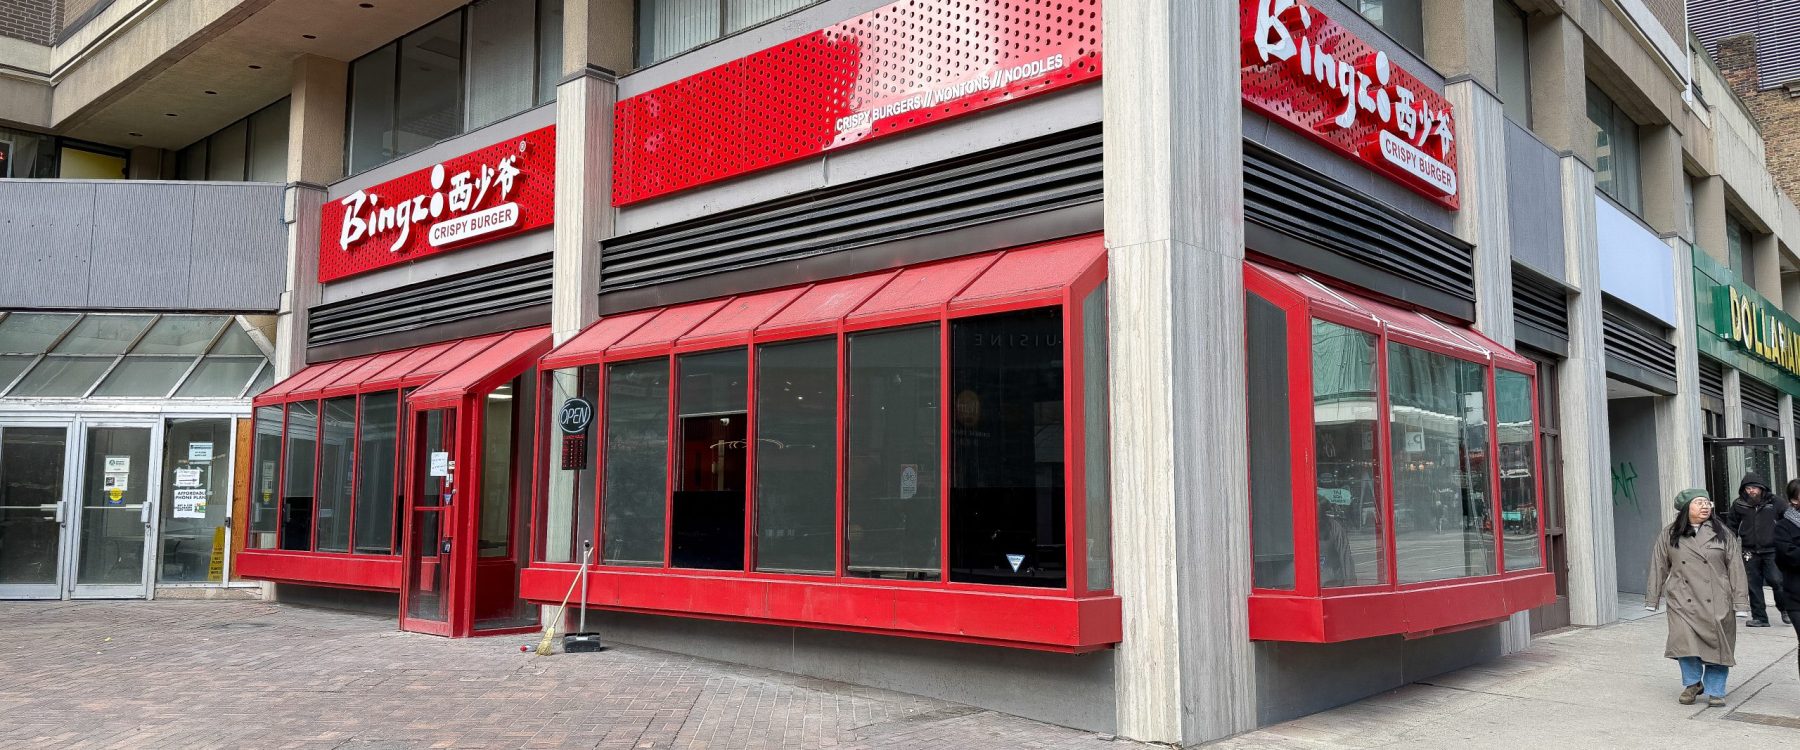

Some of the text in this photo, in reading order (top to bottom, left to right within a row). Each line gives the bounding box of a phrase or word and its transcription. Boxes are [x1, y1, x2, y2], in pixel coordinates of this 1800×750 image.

[836, 109, 870, 131] CRISPY
[872, 96, 922, 120] BURGERS
[935, 75, 991, 102] WONTONS
[1005, 54, 1063, 82] NOODLES
[1385, 139, 1452, 187] CRISPY BURGER
[434, 209, 512, 240] CRISPY BURGER
[560, 407, 588, 424] OPEN
